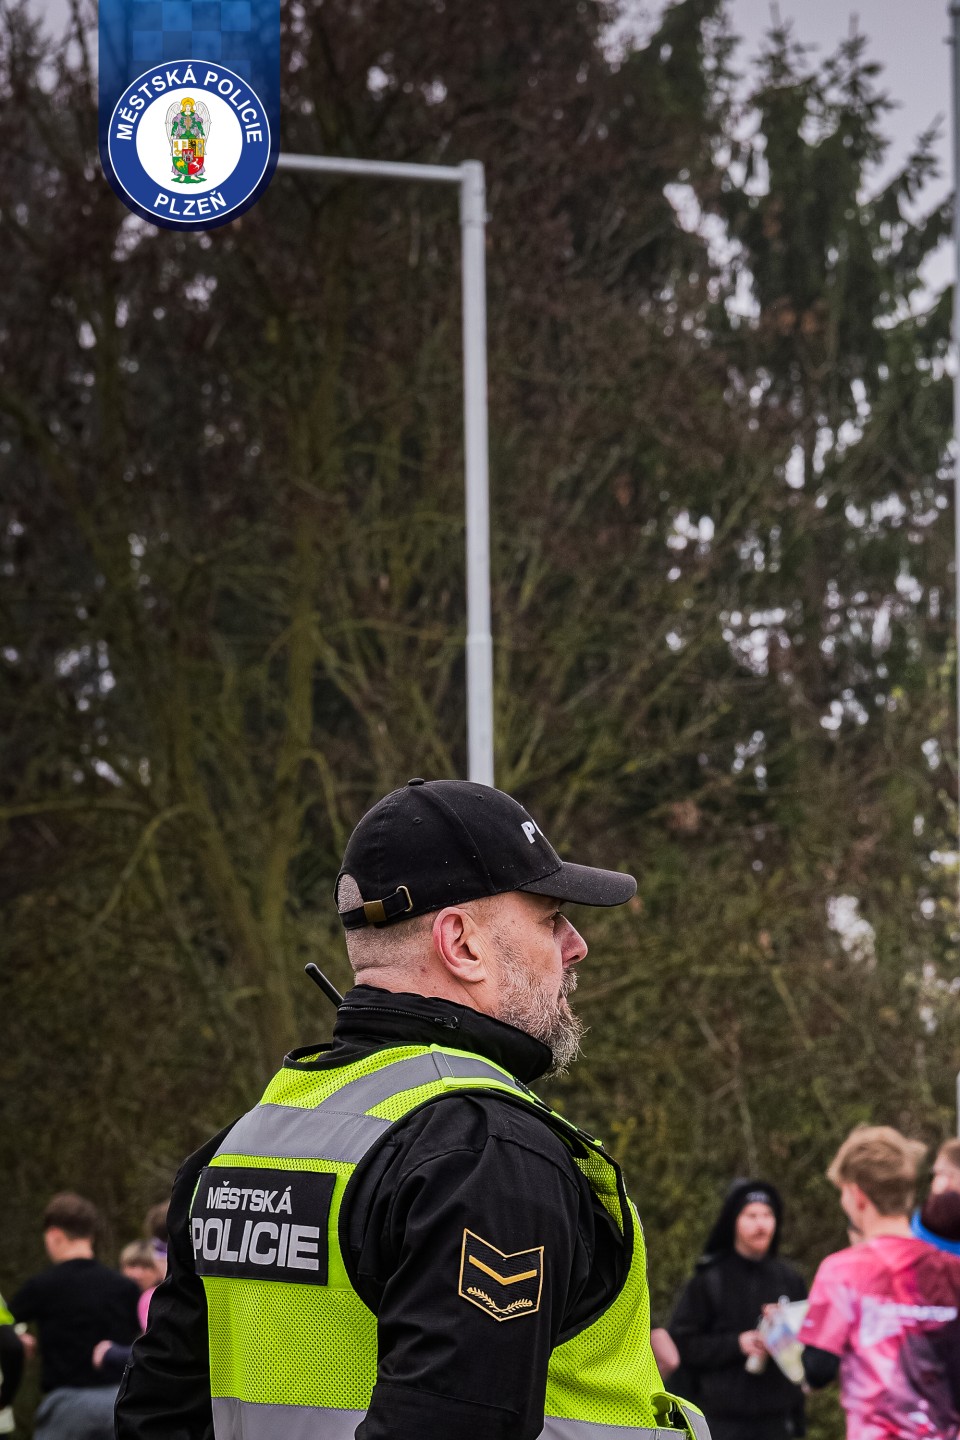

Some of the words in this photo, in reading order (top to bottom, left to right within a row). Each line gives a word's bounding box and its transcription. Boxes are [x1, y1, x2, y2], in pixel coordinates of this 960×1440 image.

[520, 819, 544, 844] P
[206, 1180, 292, 1214] MĚSTSKÁ
[191, 1217, 320, 1271] POLICIE
